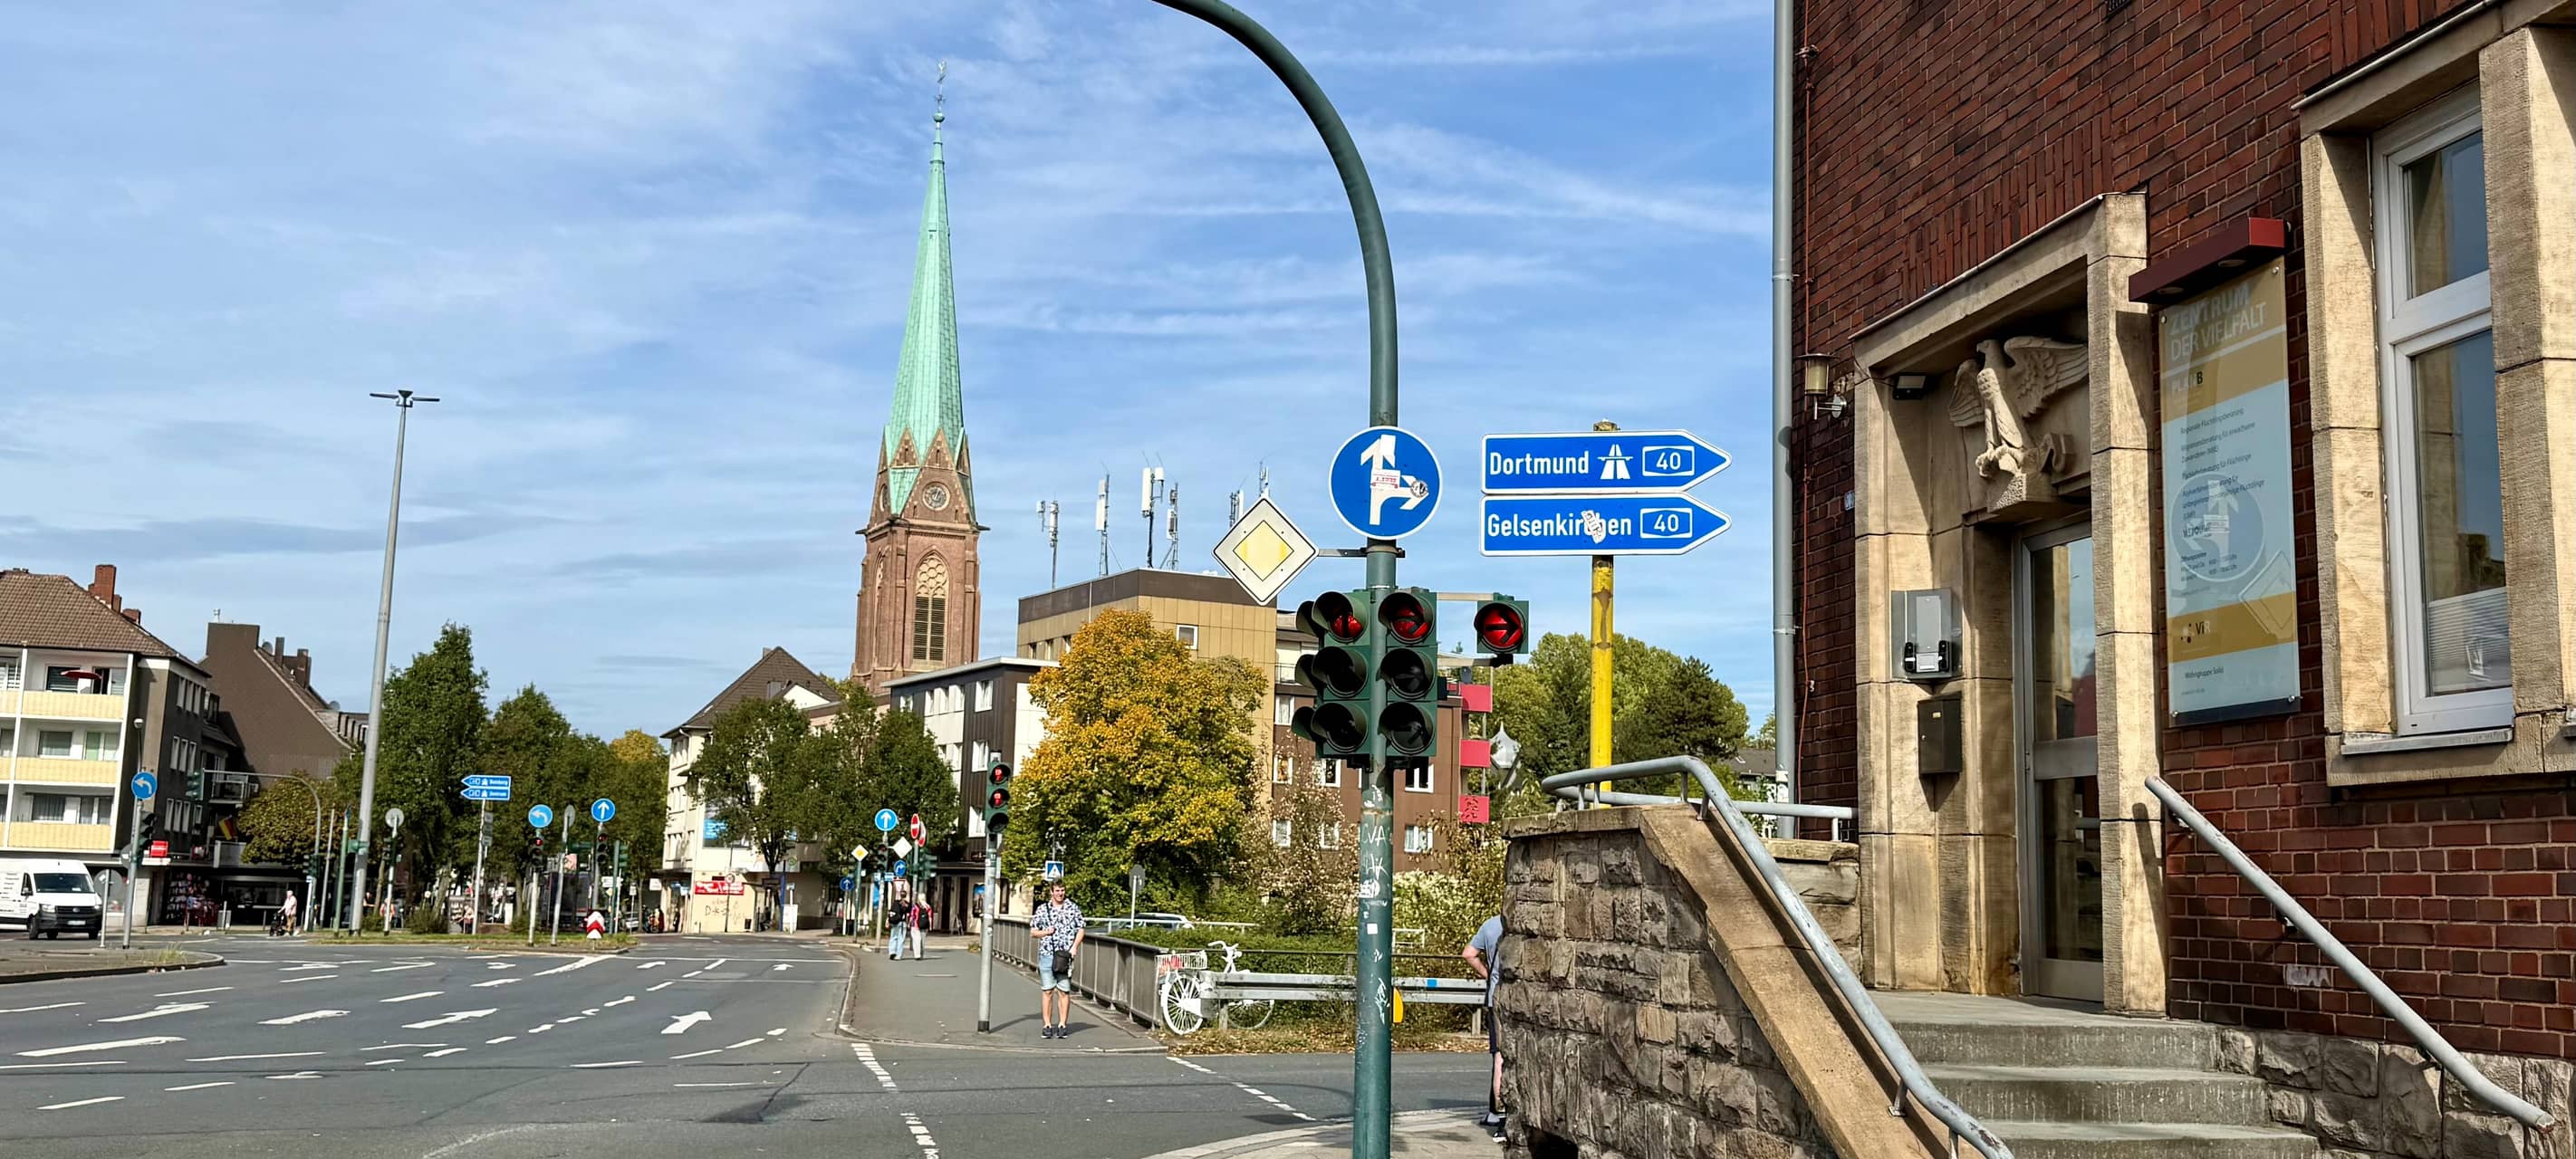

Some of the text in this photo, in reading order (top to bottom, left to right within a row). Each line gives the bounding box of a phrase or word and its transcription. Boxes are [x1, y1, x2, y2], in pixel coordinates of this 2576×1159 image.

[2170, 283, 2250, 334] ZENTRUM
[2171, 302, 2267, 360] DER VIELFALT
[2196, 371, 2204, 385] B
[1489, 451, 1682, 476] Dortmund 40
[1654, 514, 1678, 532] 40
